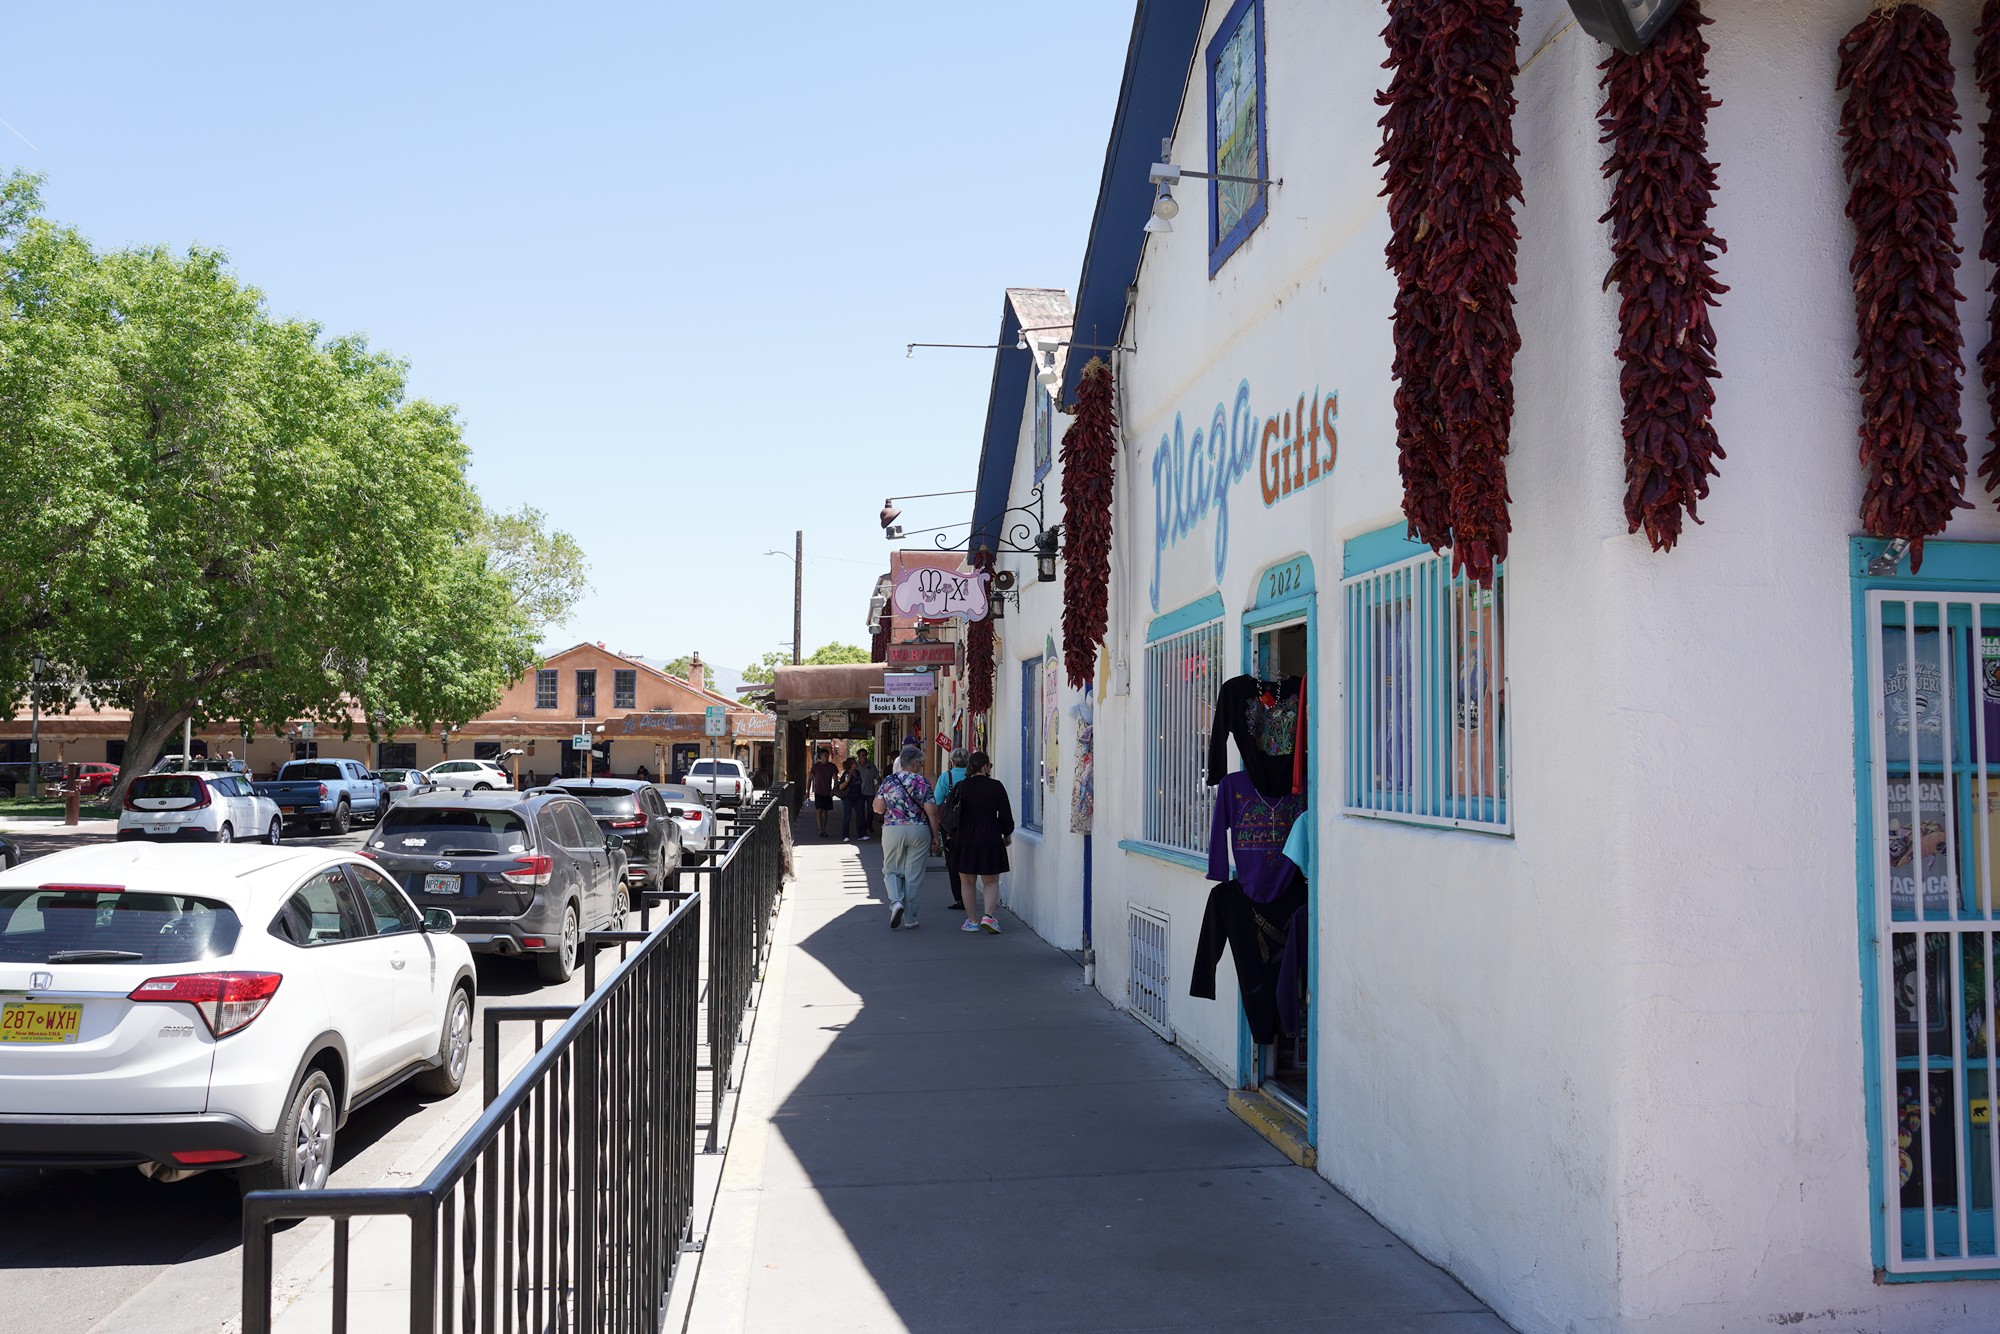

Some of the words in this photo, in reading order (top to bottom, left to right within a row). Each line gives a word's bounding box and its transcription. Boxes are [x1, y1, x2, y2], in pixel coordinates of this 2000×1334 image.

[1260, 383, 1339, 509] Gifts
[1270, 564, 1300, 599] 2022
[889, 648, 953, 661] WARPATH
[707, 707, 712, 717] 2
[735, 719, 746, 735] La
[575, 737, 583, 747] P
[3, 1010, 36, 1029] 287
[46, 1011, 77, 1029] WXH
